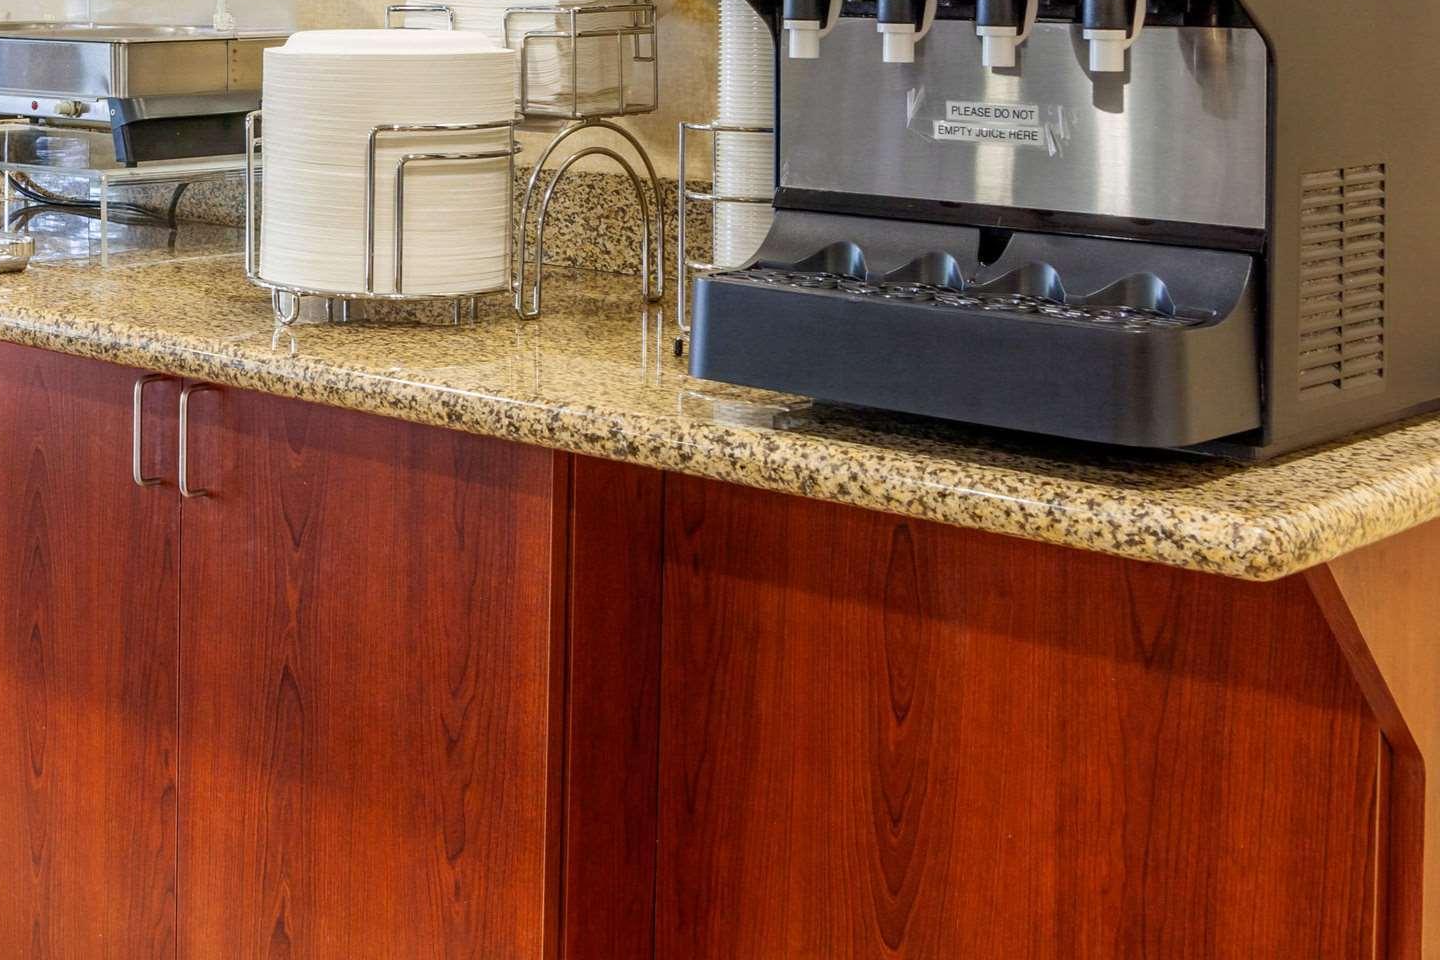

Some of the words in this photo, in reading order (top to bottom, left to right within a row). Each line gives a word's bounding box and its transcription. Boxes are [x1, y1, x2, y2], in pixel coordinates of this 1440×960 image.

[951, 105, 991, 118] PLEASE
[994, 108, 1009, 119] DO
[1012, 109, 1035, 121] NOT
[938, 125, 972, 137] EMPTY
[976, 127, 1006, 139] JUICE
[1009, 130, 1038, 141] HERE
